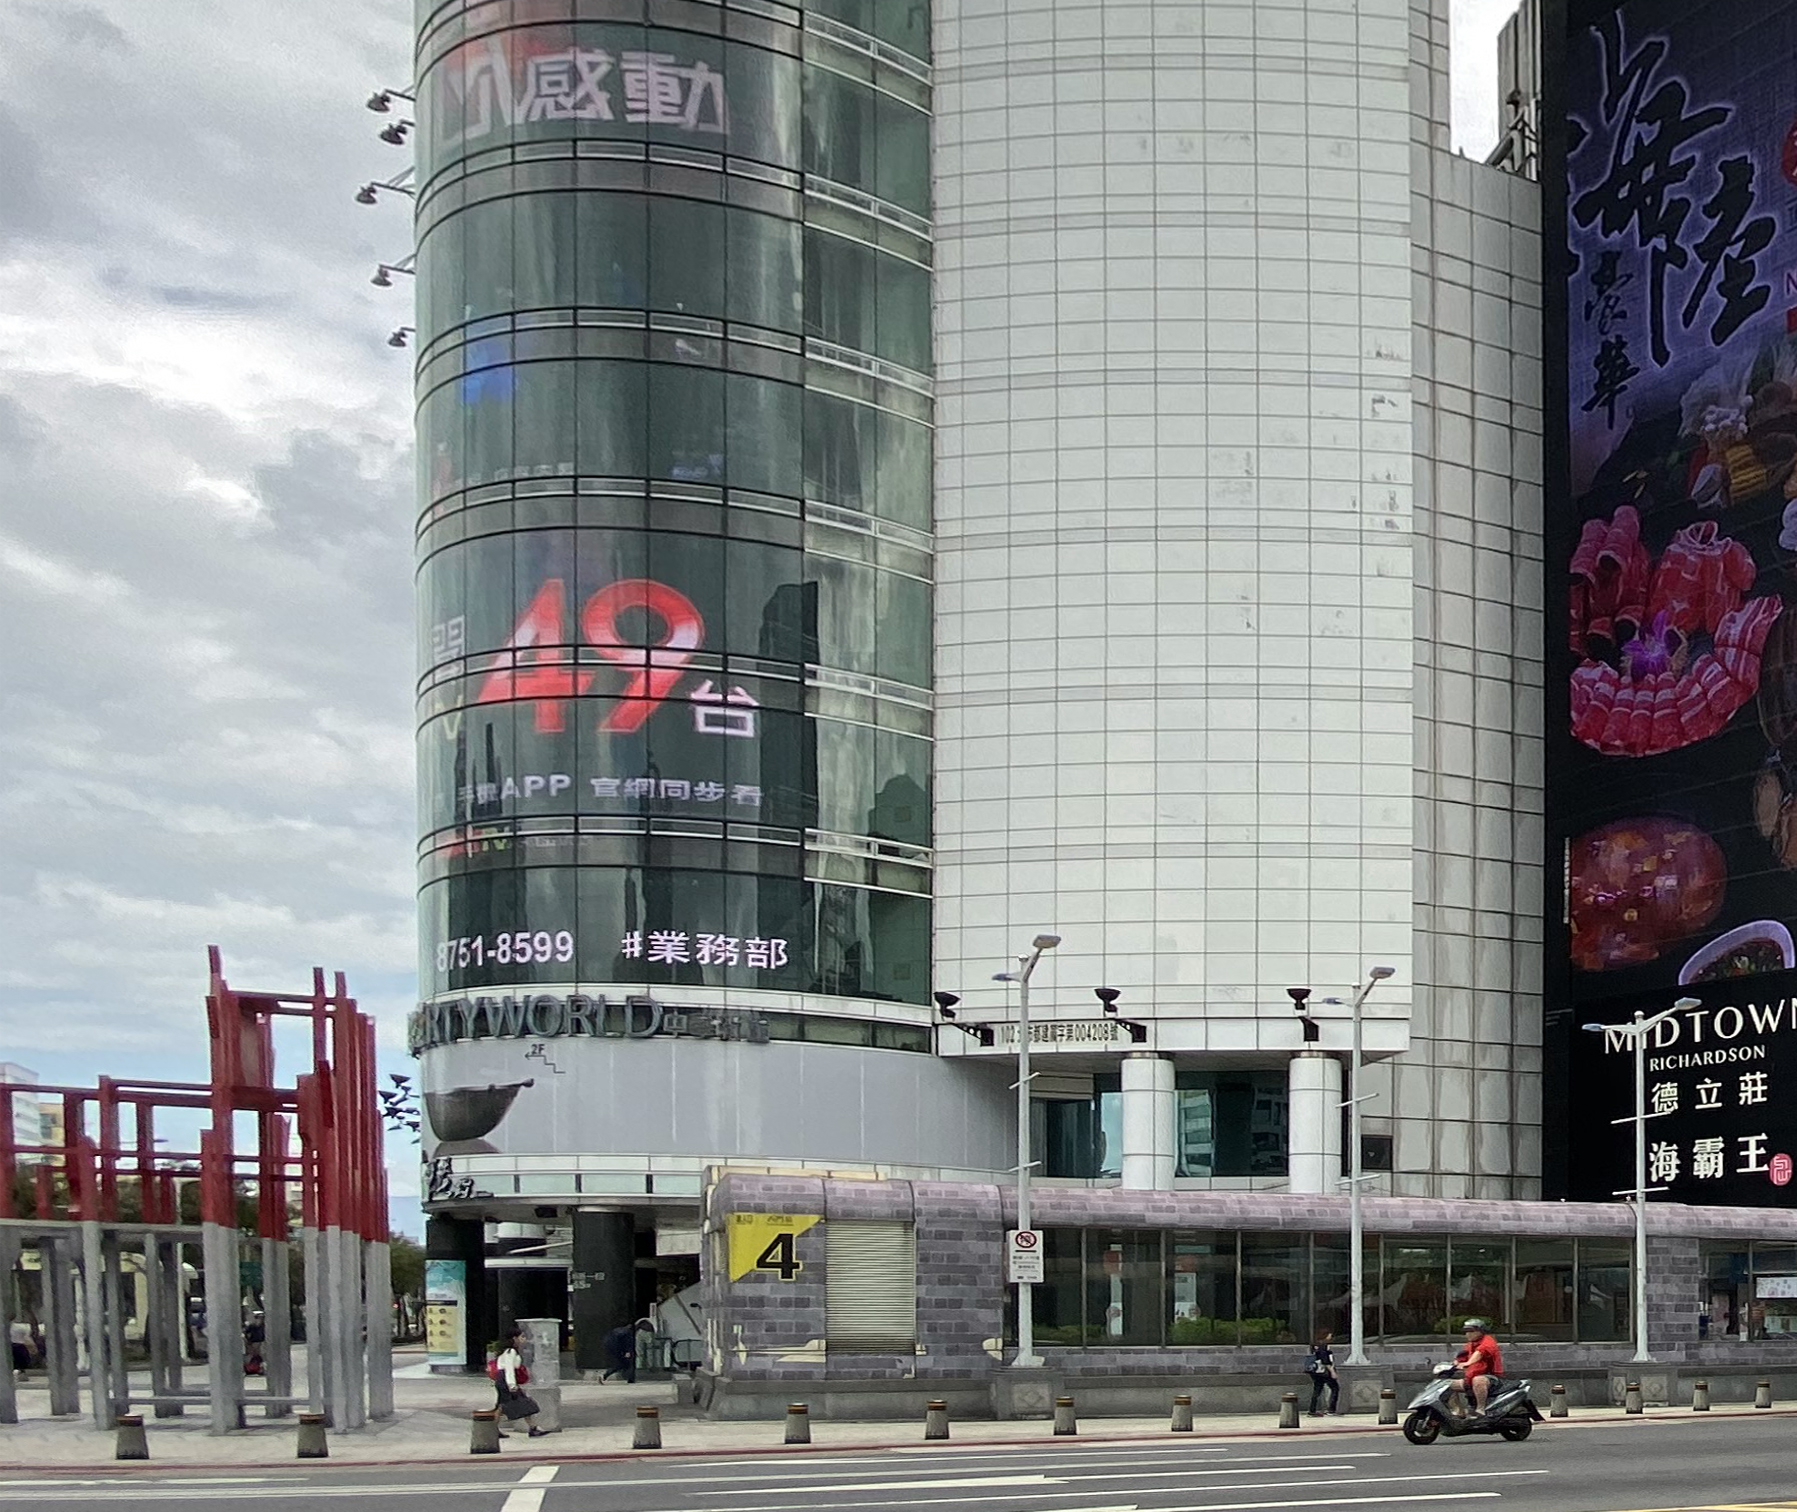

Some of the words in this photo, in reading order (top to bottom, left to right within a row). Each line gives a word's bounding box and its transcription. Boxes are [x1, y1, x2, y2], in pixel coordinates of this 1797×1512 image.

[477, 577, 760, 737] 49台
[620, 929, 790, 971] #業務部
[530, 1043, 545, 1055] 2F
[1649, 1044, 1766, 1072] RICHARDSON
[1651, 1070, 1769, 1114] 德立莊
[1649, 1132, 1770, 1182] 海霸王
[756, 1233, 801, 1280] 4
